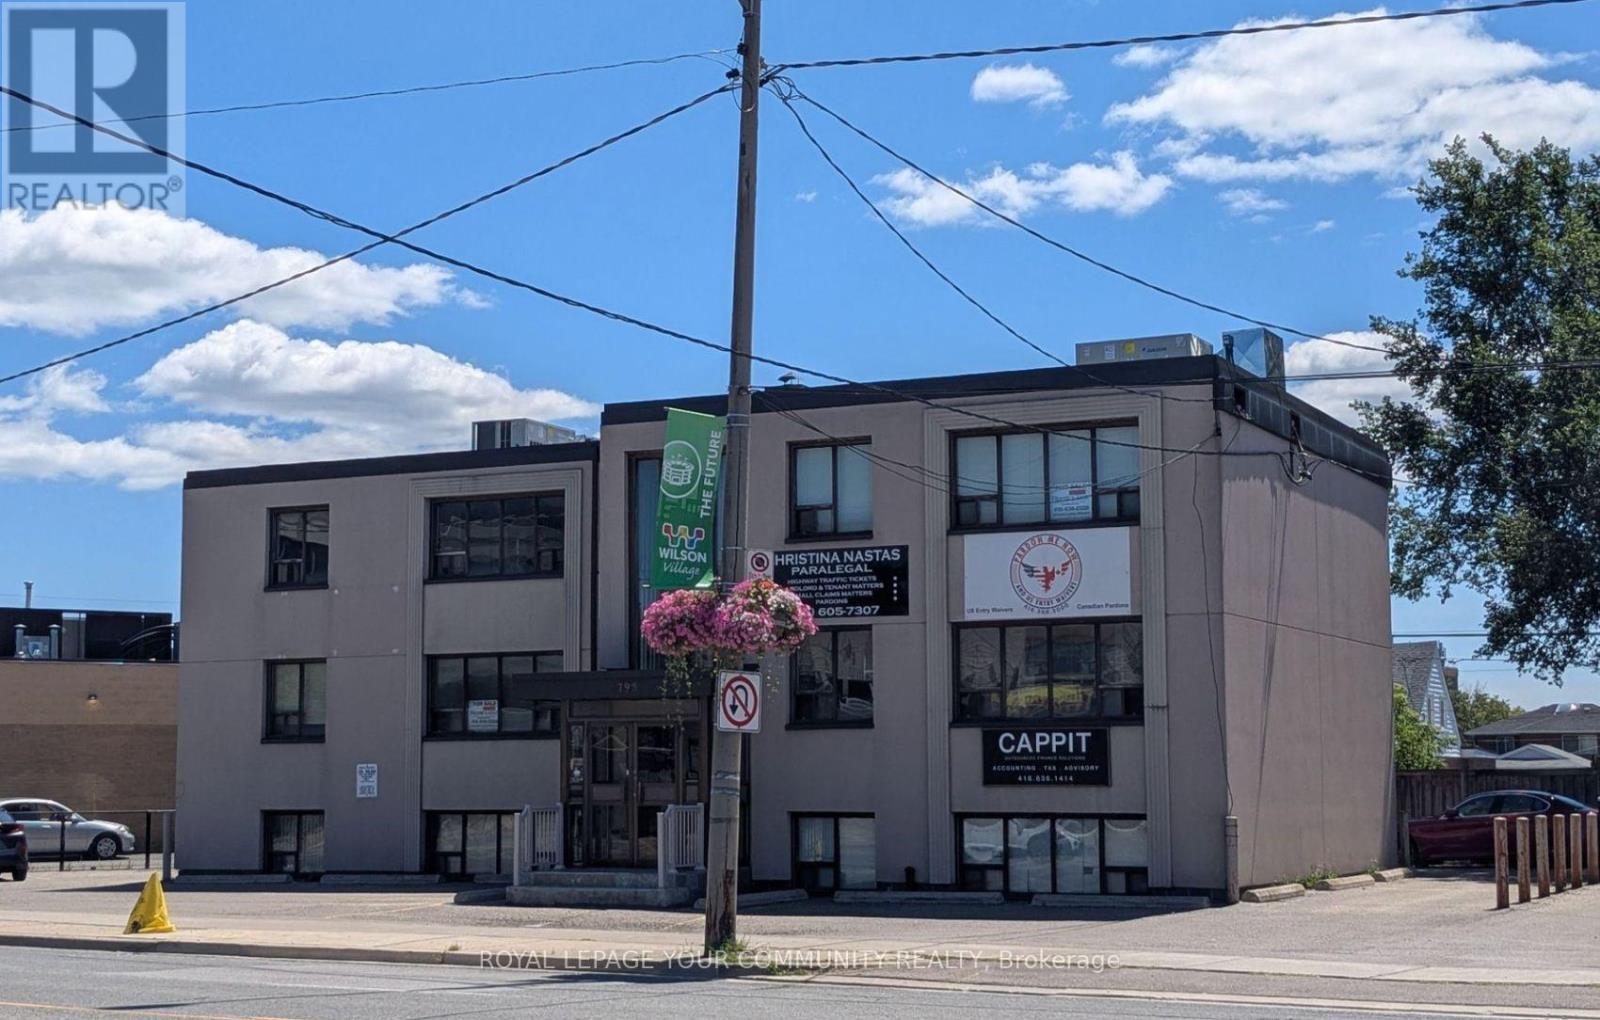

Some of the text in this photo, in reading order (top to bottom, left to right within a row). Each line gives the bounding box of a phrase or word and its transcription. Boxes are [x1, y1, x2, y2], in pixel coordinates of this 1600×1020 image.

[700, 430, 722, 519] THE FUTURE
[659, 547, 707, 564] WILSON
[774, 549, 901, 566] HRISTINA NASTAS
[663, 561, 701, 580] Village
[791, 564, 873, 576] PARALEGAL
[818, 605, 880, 616] 605-7307
[1105, 601, 1129, 609] Pardons
[998, 732, 1092, 753] CAPPIT
